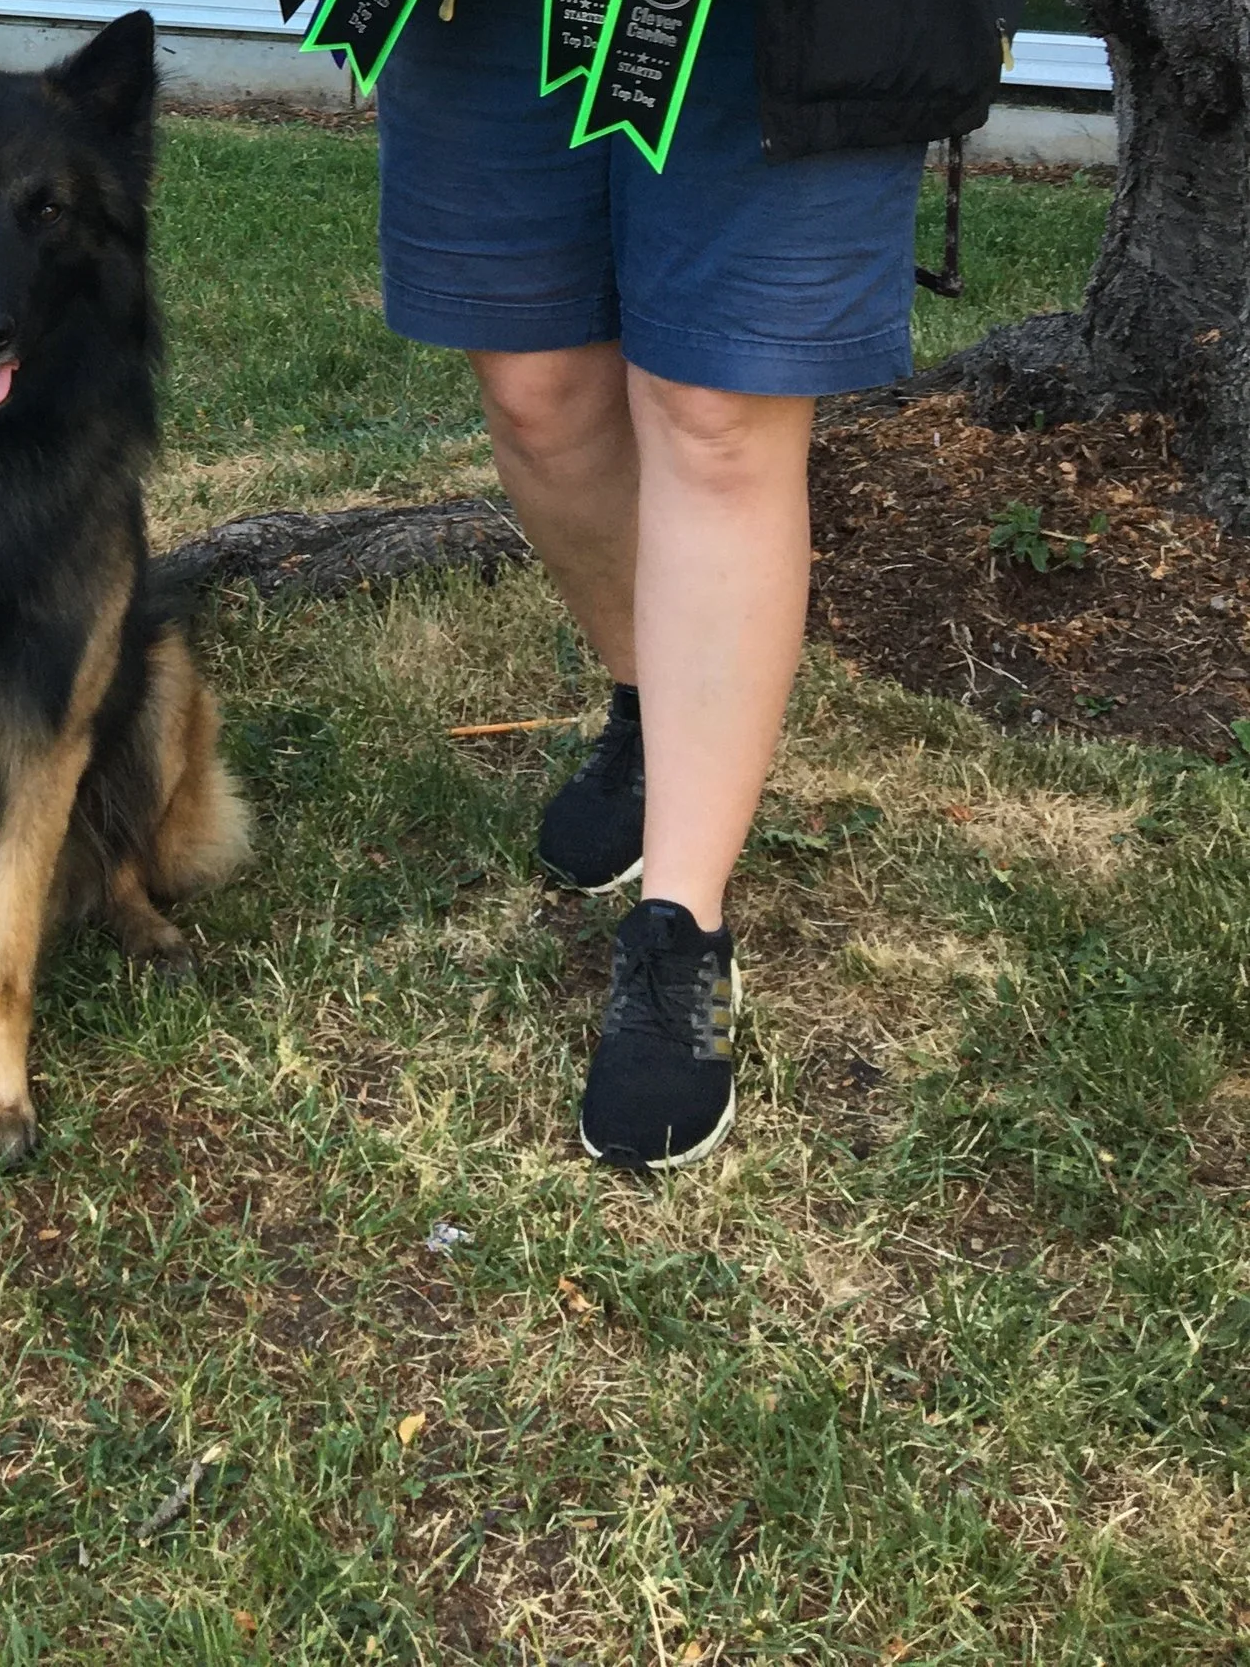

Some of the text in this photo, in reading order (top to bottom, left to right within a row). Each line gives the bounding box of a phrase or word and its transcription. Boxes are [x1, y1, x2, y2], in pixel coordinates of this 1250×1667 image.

[631, 6, 683, 31] Clever
[561, 31, 598, 49] Top Do
[626, 21, 678, 48] Canine
[616, 61, 663, 81] STARTED
[611, 83, 657, 108] Top Dog
